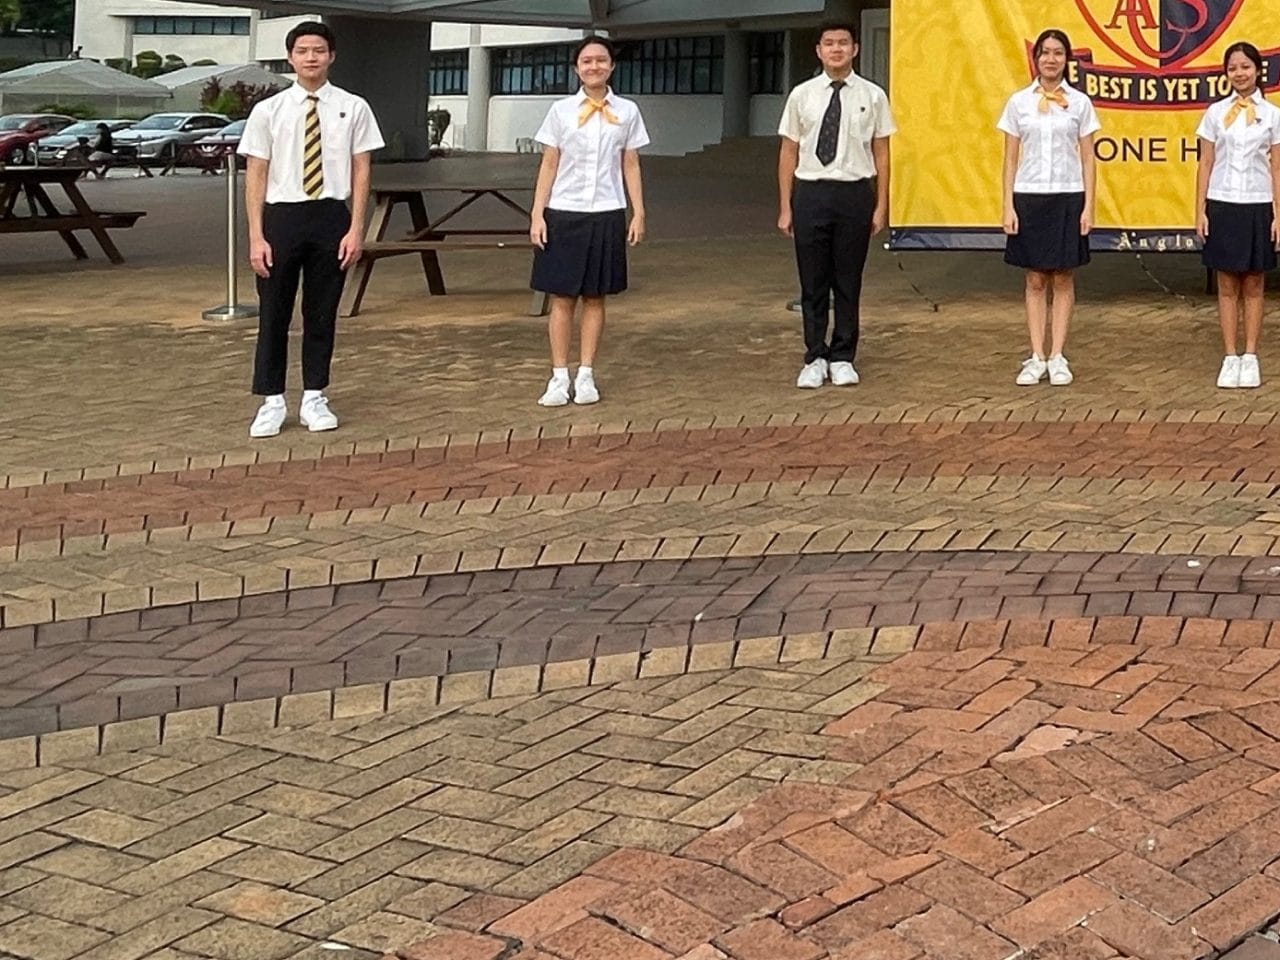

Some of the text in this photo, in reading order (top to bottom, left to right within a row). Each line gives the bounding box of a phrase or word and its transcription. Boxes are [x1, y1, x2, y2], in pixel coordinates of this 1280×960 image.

[1086, 73, 1231, 102] BEST IS YET TO
[1094, 137, 1168, 162] ONE
